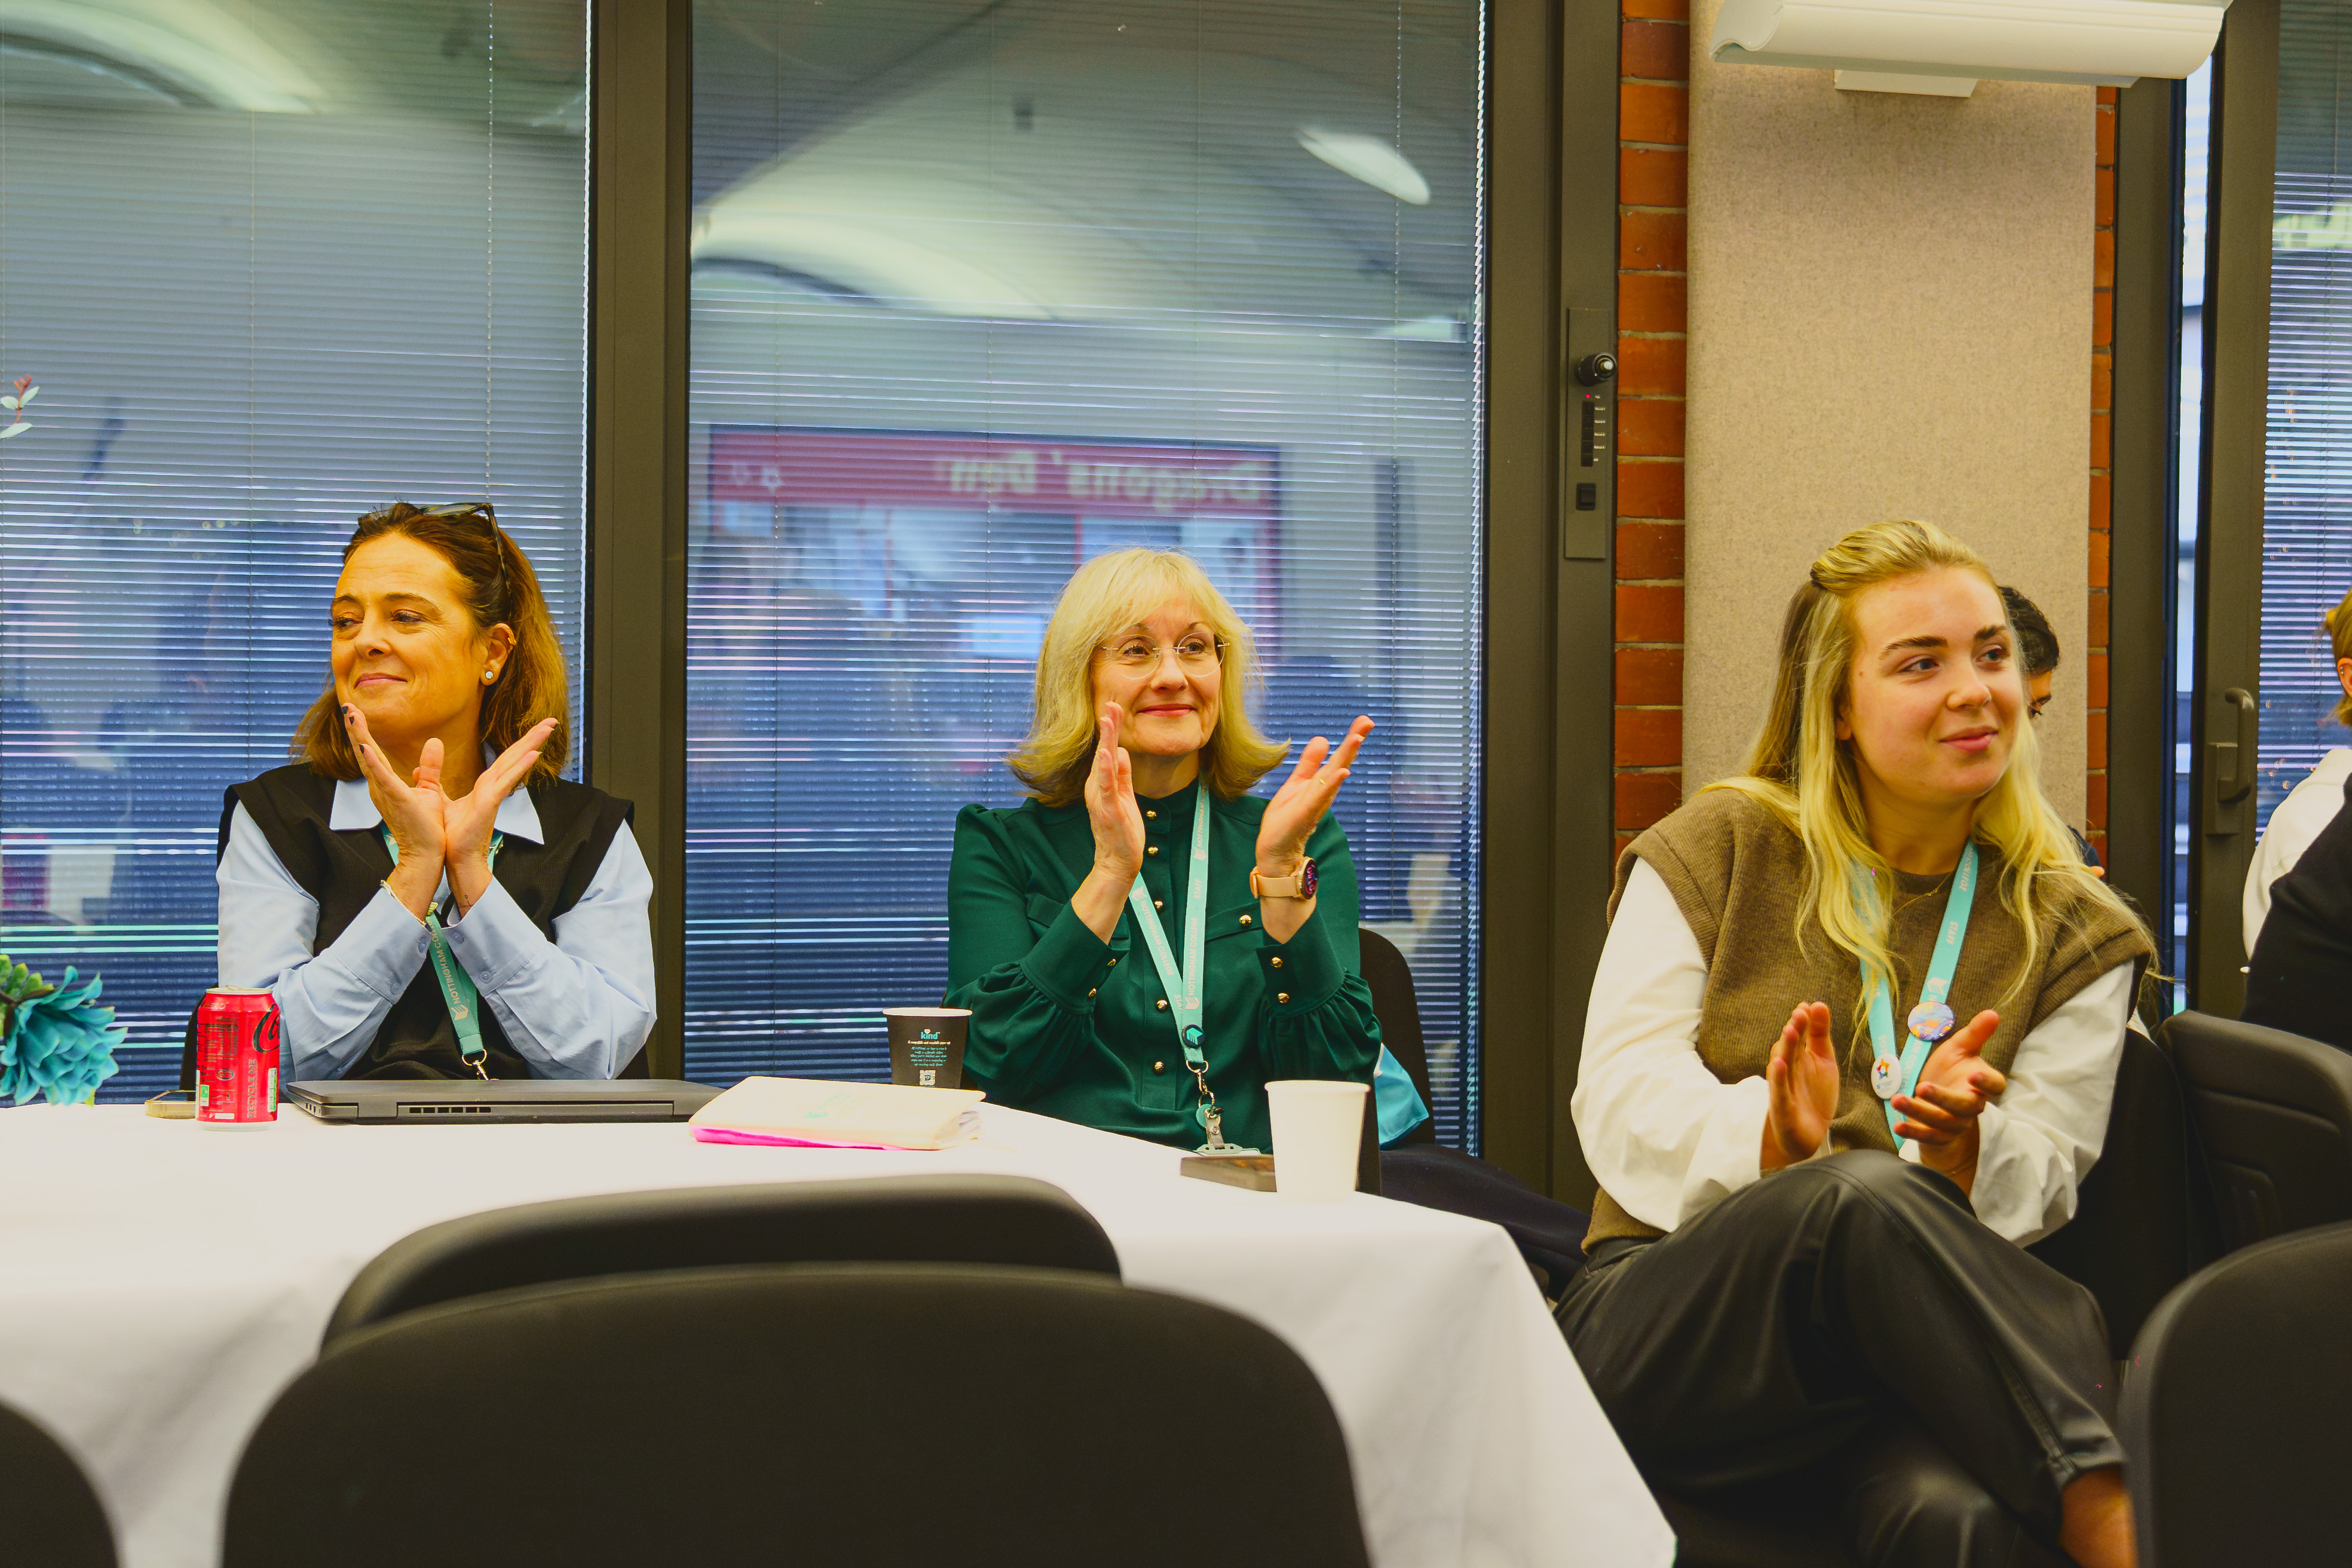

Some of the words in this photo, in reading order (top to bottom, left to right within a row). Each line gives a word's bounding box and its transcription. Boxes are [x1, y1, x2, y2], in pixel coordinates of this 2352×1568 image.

[1193, 878, 1202, 899] STAFF
[1139, 899, 1162, 946] NOTTINGHAM
[1157, 946, 1174, 976] COLLEGE
[1190, 917, 1199, 948] COLLEGE
[1945, 920, 1958, 945] STAFF
[436, 950, 461, 1004] NOTTINGHAM
[1188, 948, 1197, 996] NOTTINGHAM
[921, 1030, 938, 1040] kind
[248, 1058, 256, 1074] ME
[247, 1076, 256, 1119] RECYCLE
